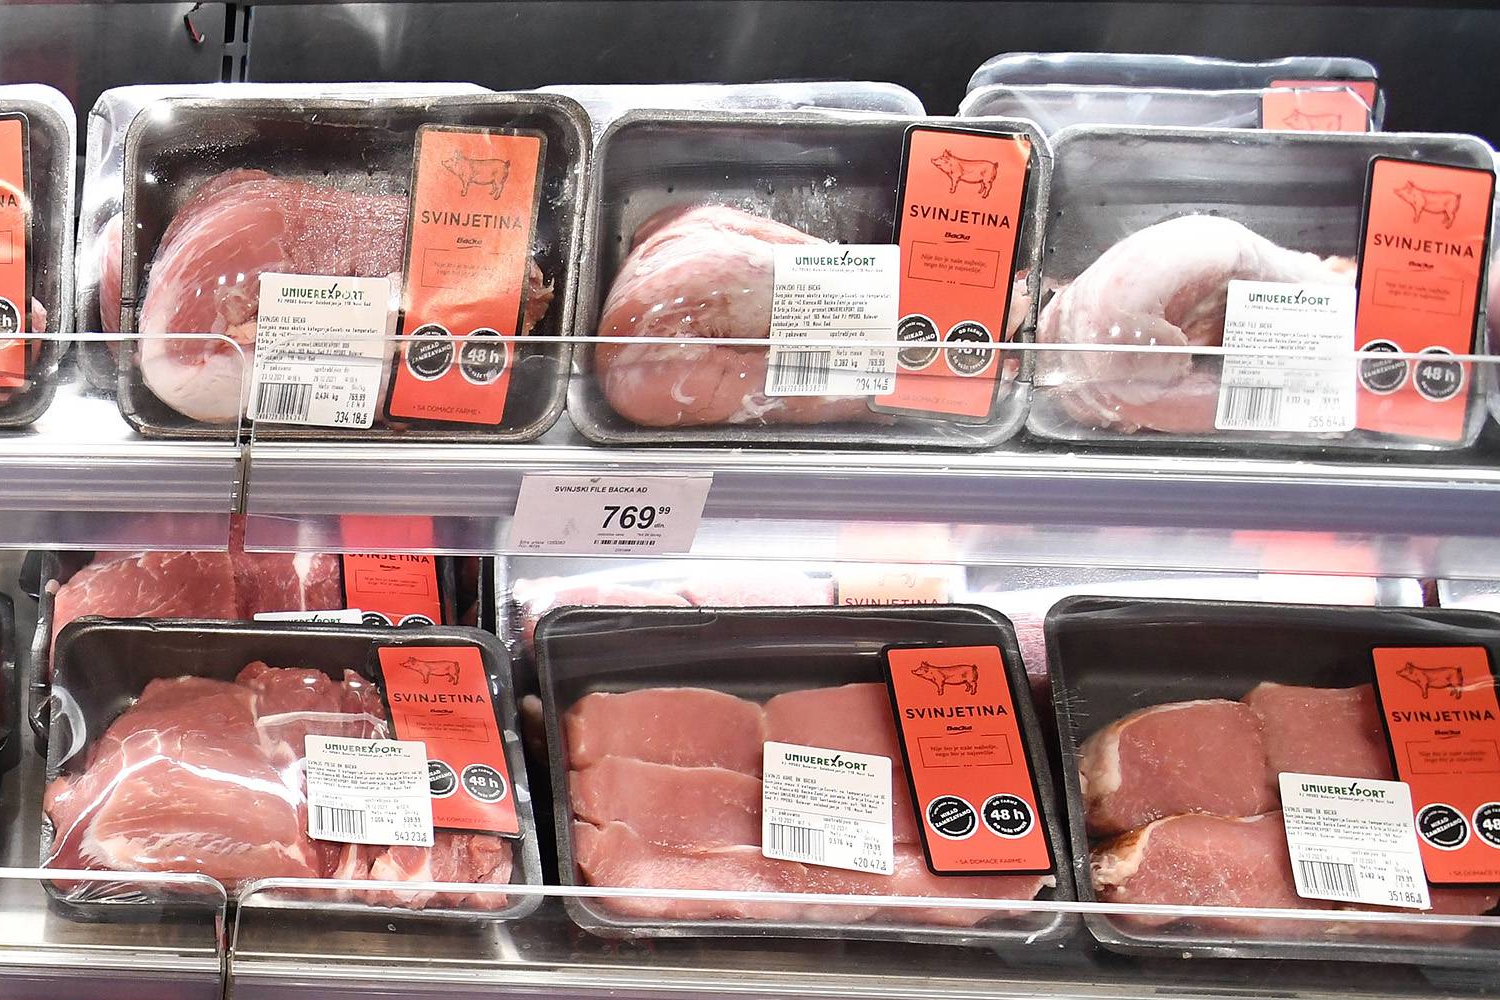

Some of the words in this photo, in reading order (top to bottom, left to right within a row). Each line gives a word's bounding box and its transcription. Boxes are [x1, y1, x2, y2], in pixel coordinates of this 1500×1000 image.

[421, 211, 522, 230] SVINJETINA
[910, 205, 1010, 228] SVINJETINA
[1373, 234, 1474, 258] SVINJETINA
[796, 253, 875, 266] UNIVEREXPORT
[282, 285, 364, 300] UNIVEREXPORT
[1249, 292, 1330, 306] UNIVEREXPORT
[2, 315, 12, 327] h
[467, 350, 487, 362] 48
[489, 351, 499, 364] h
[1422, 366, 1442, 380] 48
[1444, 367, 1455, 382] h
[602, 506, 656, 529] 769
[659, 507, 671, 515] 99
[393, 692, 485, 704] SVINJETINA
[905, 704, 1008, 719] SVINJETINA
[1392, 710, 1495, 722] SVINJETINA
[325, 744, 404, 755] UNIVEREXPORT
[785, 756, 867, 771] UNIVEREXPORT
[469, 774, 488, 786] 48
[489, 777, 499, 789] h
[1301, 784, 1386, 799] UNIVEREXPORT
[990, 809, 1010, 821] 48
[1013, 809, 1024, 821] h
[1483, 819, 1500, 830] 48
